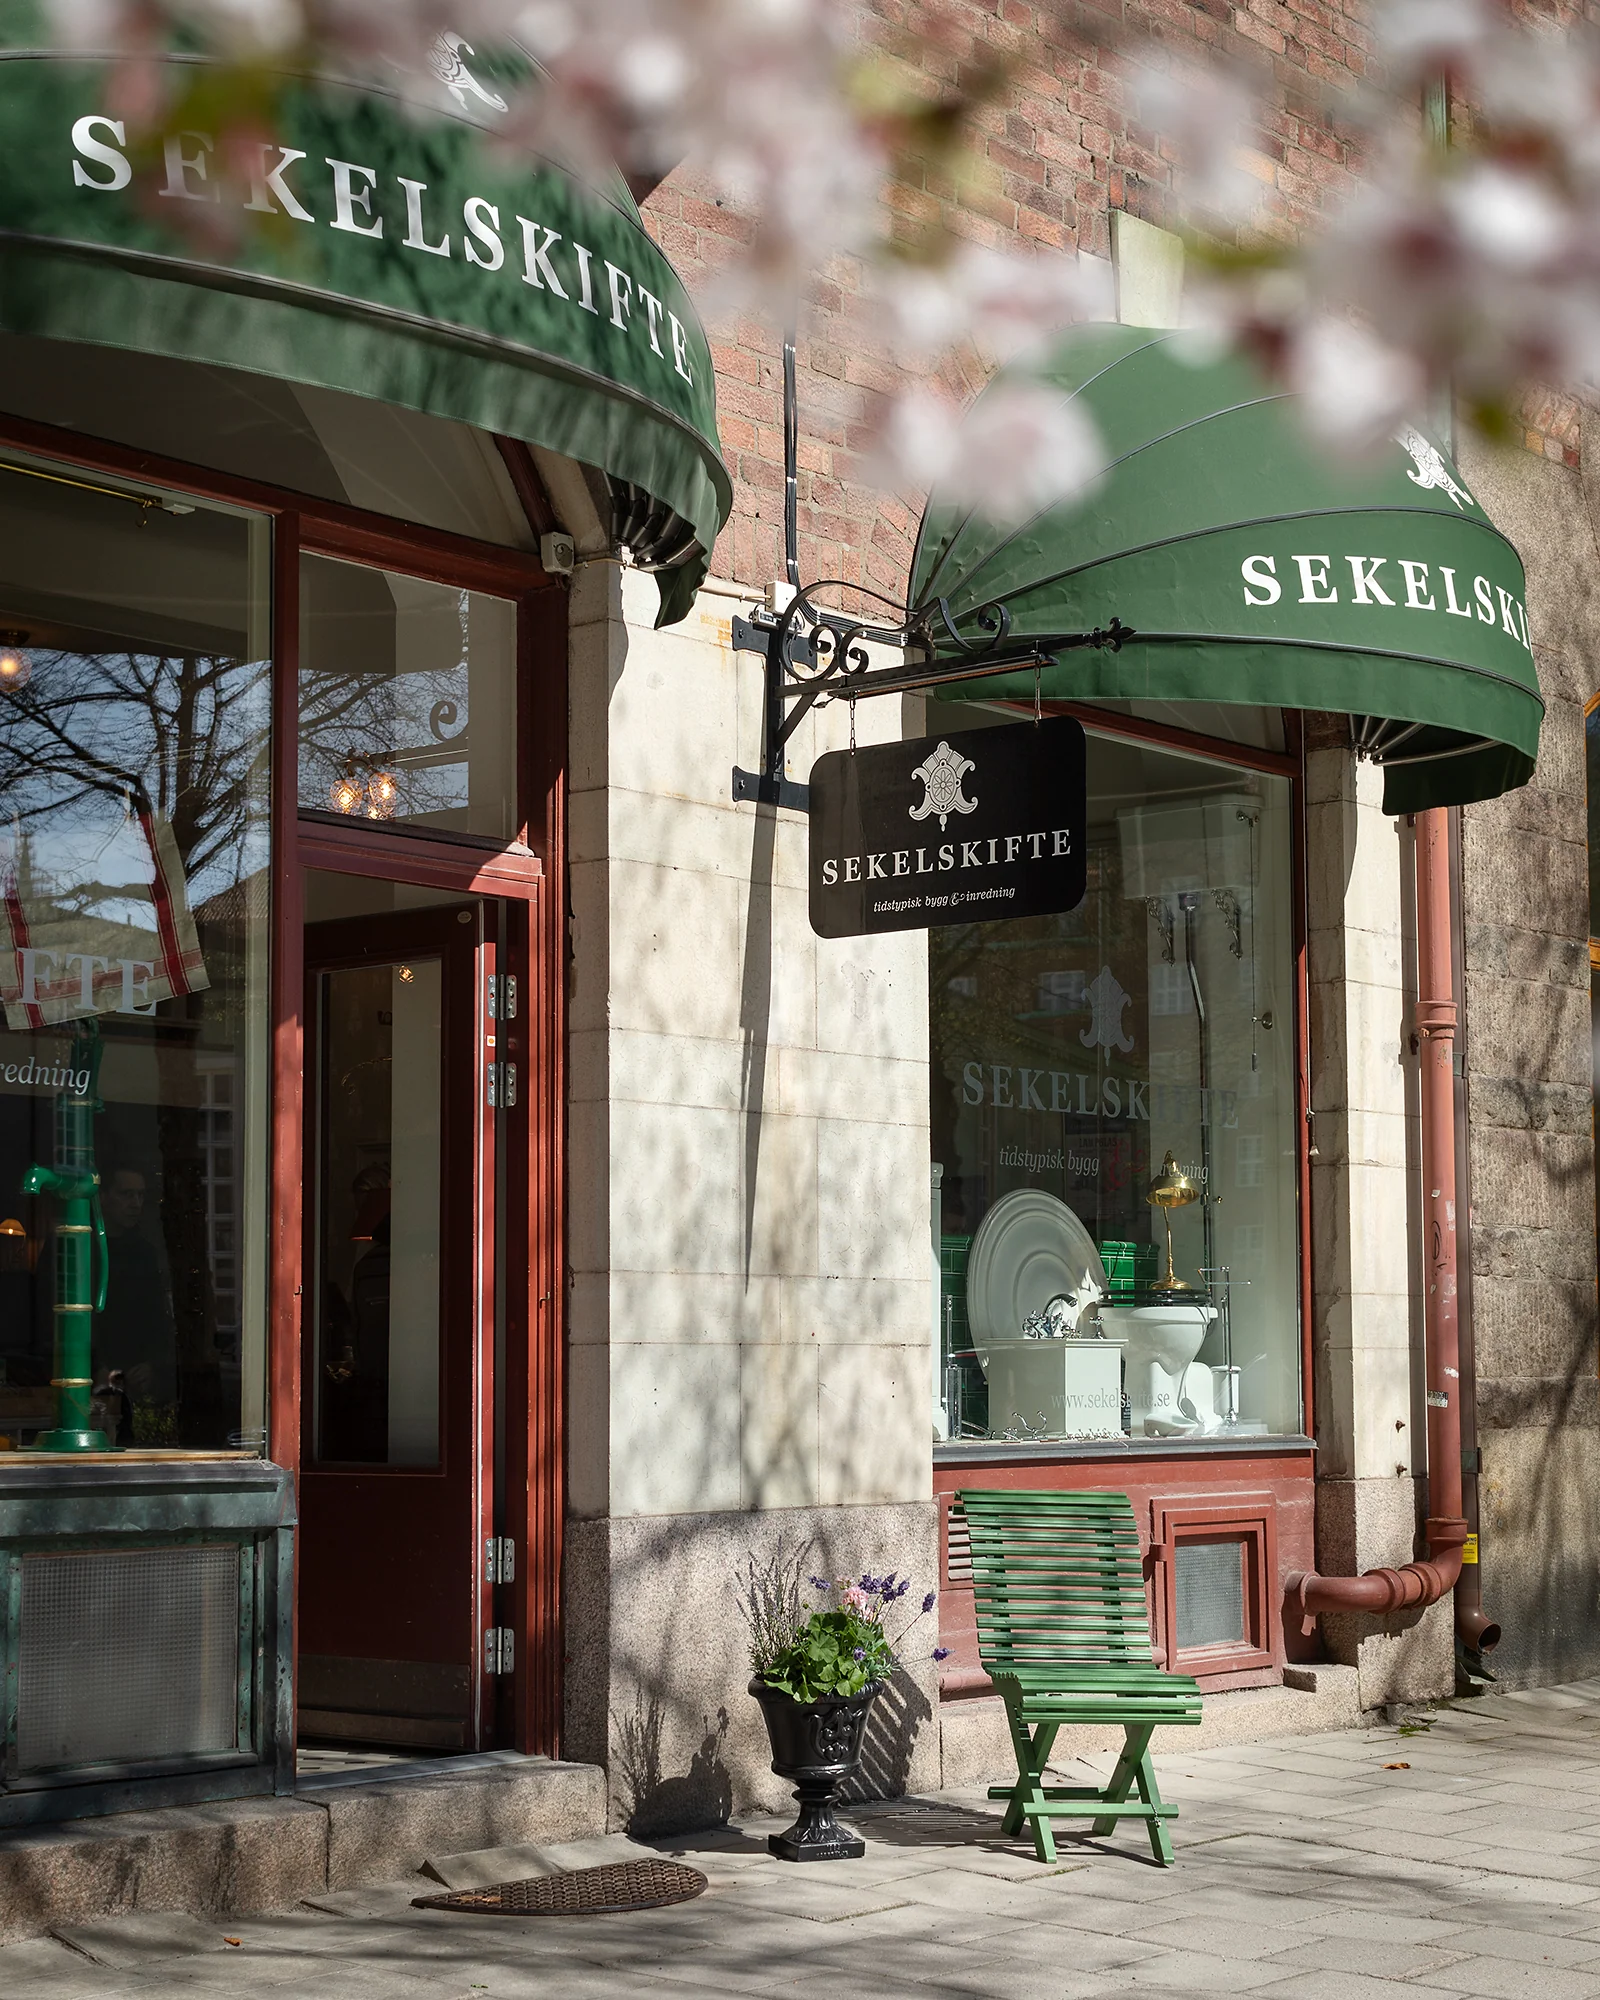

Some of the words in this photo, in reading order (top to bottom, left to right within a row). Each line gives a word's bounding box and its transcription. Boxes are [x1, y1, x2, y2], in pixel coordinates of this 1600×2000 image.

[71, 115, 693, 389] SEKELSKIFTE
[1240, 555, 1533, 659] SEKELSKI
[822, 829, 1071, 886] SEKELSKIFTE
[873, 897, 922, 912] tidstypisk
[925, 894, 949, 909] bygg
[966, 887, 1015, 904] inredning
[0, 947, 157, 1016] FTE
[1000, 1146, 1065, 1173] tidstypisk
[1067, 1149, 1100, 1177] bygg
[1051, 1387, 1170, 1408] www.sekelskfte.se
